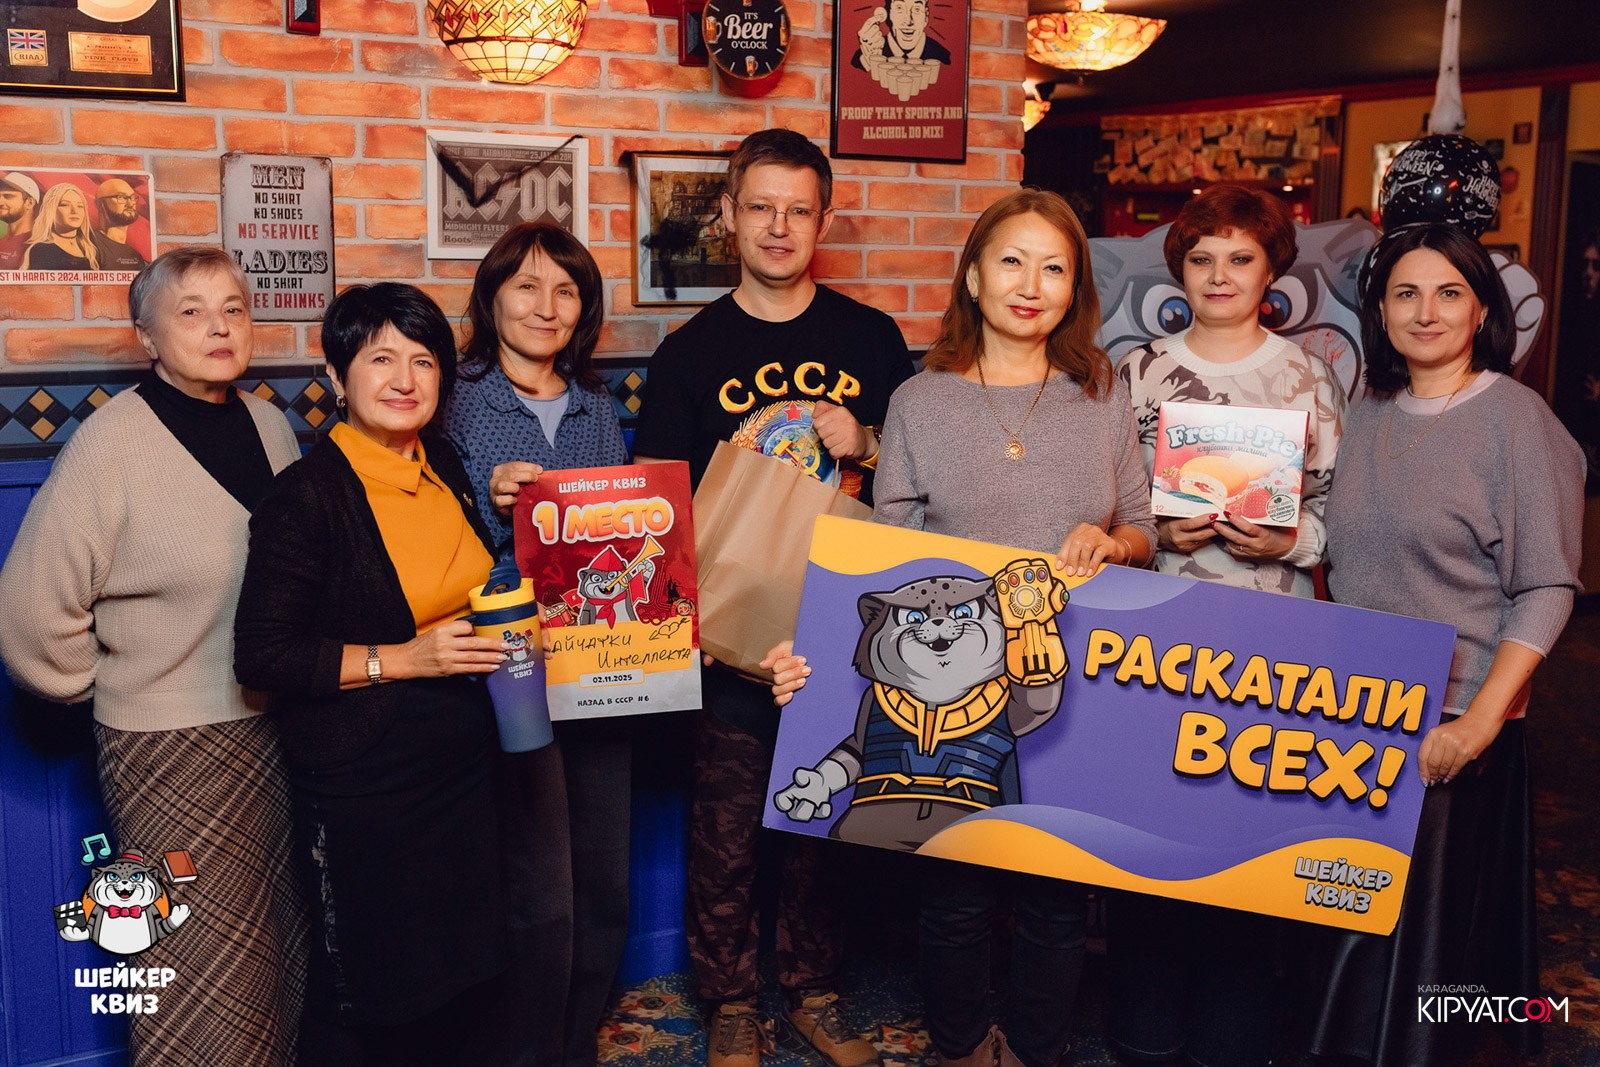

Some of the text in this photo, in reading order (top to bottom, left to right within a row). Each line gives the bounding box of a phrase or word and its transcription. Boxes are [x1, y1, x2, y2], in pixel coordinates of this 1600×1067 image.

[744, 12, 758, 20] IT'S
[724, 14, 774, 39] Beer
[731, 40, 768, 49] O'CLOCK
[841, 107, 963, 120] PROOF THAT SPORTS AND
[863, 126, 944, 139] ALCOHOL DO MIX!
[250, 164, 305, 190] MEN
[255, 192, 301, 205] NO SHIRT
[254, 208, 303, 220] NO SHOES
[238, 223, 319, 240] NO SERVICE
[444, 222, 481, 232] MIDNIGHT
[444, 234, 471, 244] Roots
[232, 249, 329, 274] LADIES
[12, 272, 21, 281] IN
[23, 272, 55, 282] HARATS
[83, 272, 114, 282] HARATS
[257, 277, 303, 289] NO SHIRT
[254, 293, 325, 308] EE DRINKS
[719, 361, 861, 414] СССР
[558, 477, 647, 494] ШЕЙКЕР КВИЗ
[1155, 504, 1164, 513] 12
[534, 499, 672, 543] 1 МЕСТО
[508, 661, 535, 673] ШЕЙКЕР
[513, 669, 533, 679] КВИЗ
[592, 673, 633, 683] 02.11.2025
[1083, 629, 1427, 735] РАСКАТАЛИ
[577, 698, 604, 707] НАЗАД
[615, 696, 634, 704] СССР
[1172, 710, 1407, 811] ВСЕХ!
[1294, 856, 1393, 892] ШЕЙКЕР
[1305, 883, 1371, 913] КВИЗ
